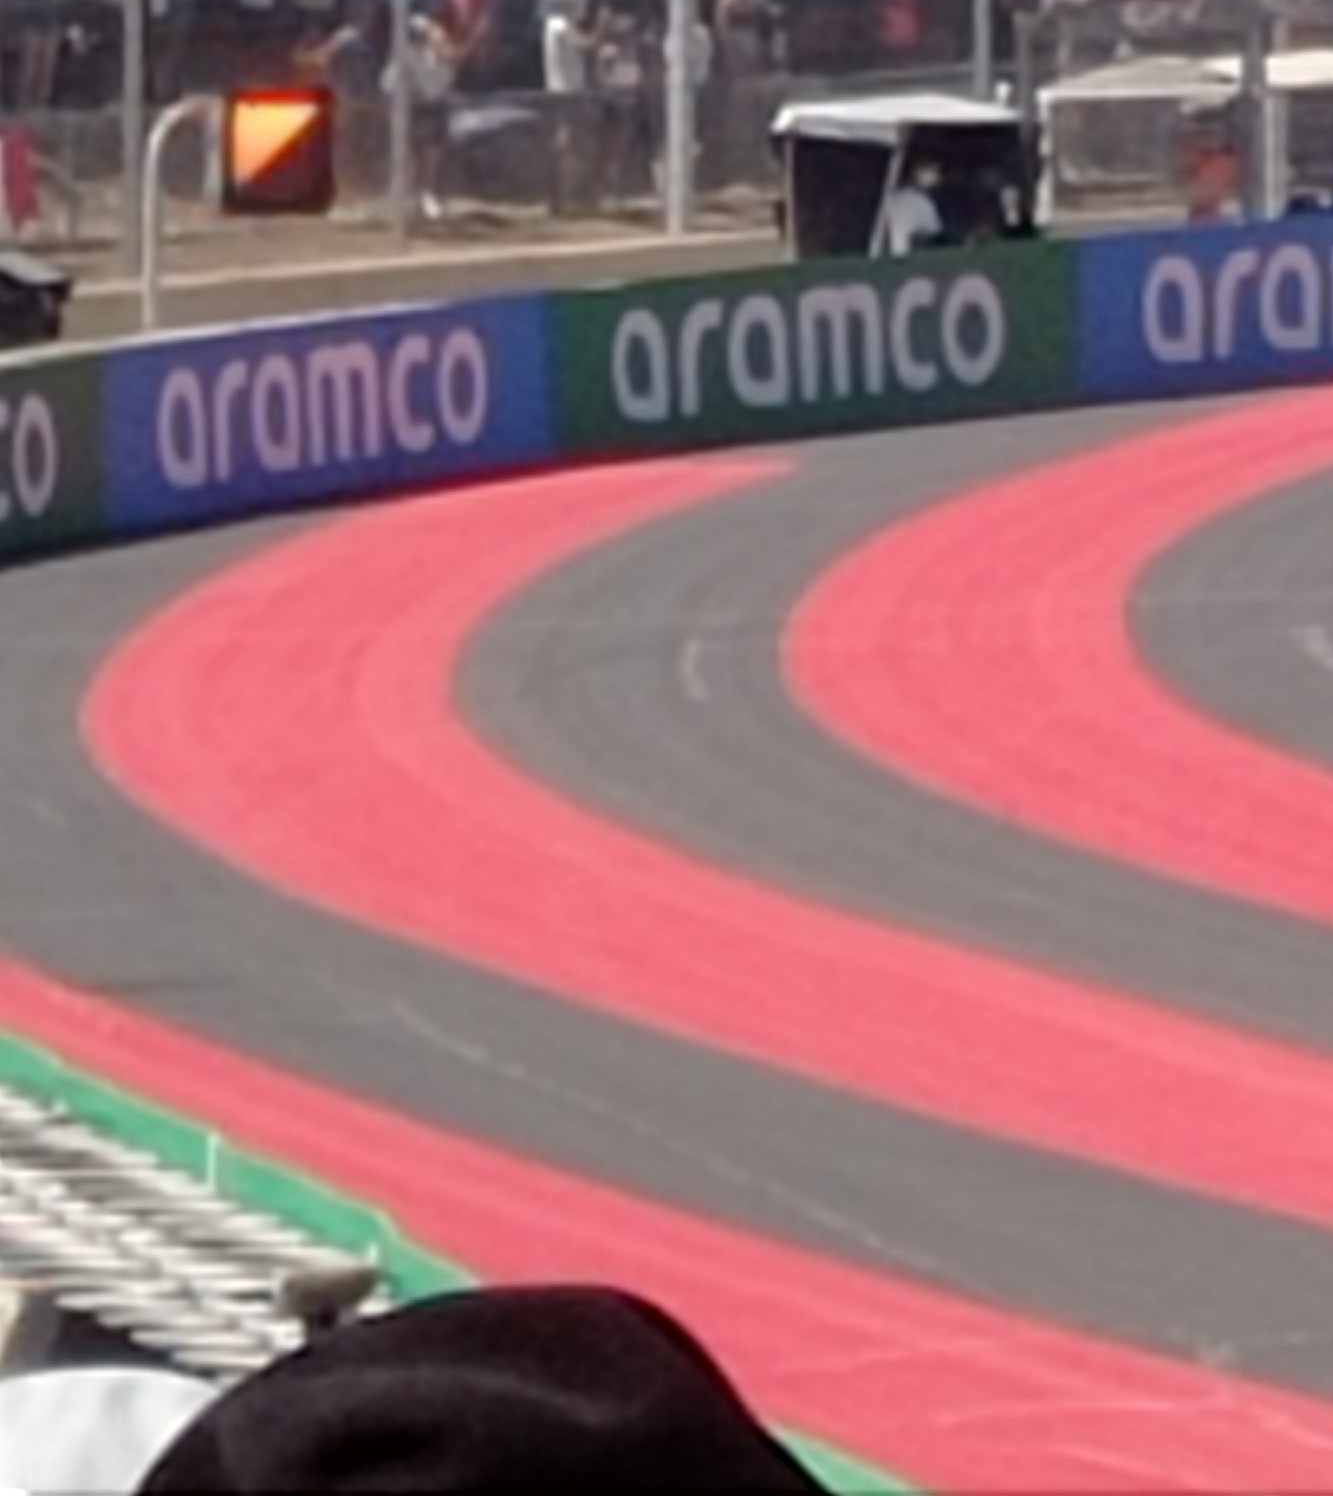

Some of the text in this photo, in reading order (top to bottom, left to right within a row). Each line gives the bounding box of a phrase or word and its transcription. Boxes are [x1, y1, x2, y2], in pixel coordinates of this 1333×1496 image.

[160, 329, 487, 488] aramco
[613, 273, 1006, 419] aramco
[0, 393, 56, 519] o
